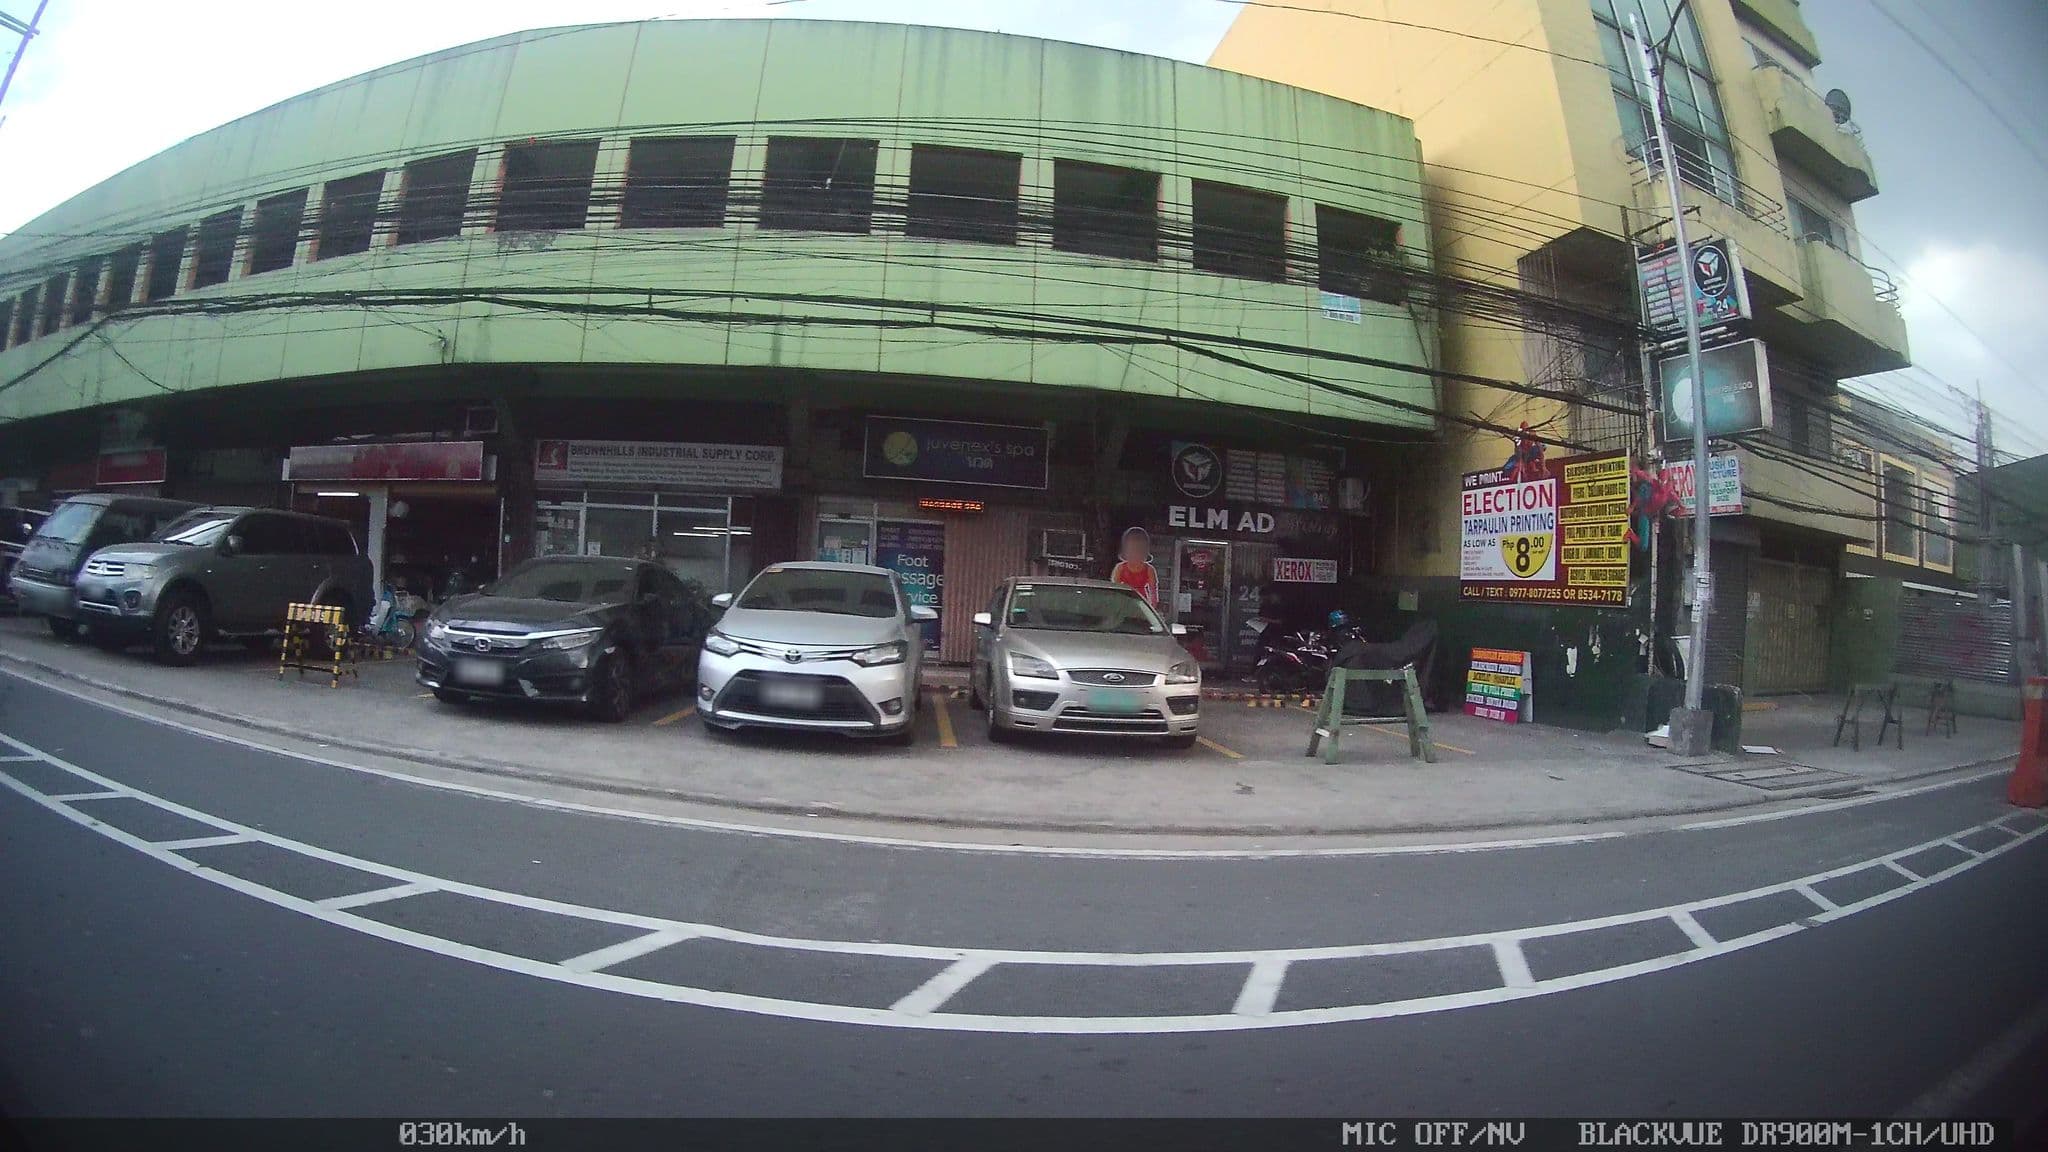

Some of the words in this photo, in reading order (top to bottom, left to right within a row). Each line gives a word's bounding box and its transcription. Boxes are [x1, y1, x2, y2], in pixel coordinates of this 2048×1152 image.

[571, 445, 634, 456] BROWNHILLS
[638, 446, 698, 458] INDUSTRIAL
[703, 448, 742, 459] SUPPLY
[746, 450, 776, 461] CORP.
[1007, 441, 1034, 457] spa
[1464, 475, 1477, 487] WE
[1464, 483, 1553, 515] ELECTION
[1168, 505, 1229, 530] ELM
[1237, 511, 1275, 533] AD
[1464, 516, 1508, 535] TARPAULIN
[1510, 512, 1554, 532] PRINTING
[1464, 540, 1471, 548] AS
[1472, 539, 1486, 548] LOW
[1488, 538, 1496, 547] AS
[897, 553, 929, 568] Foot
[1276, 560, 1313, 581] XEROX
[901, 572, 944, 590] ssage
[1239, 585, 1261, 602] 24
[1463, 586, 1480, 597] CALL
[1486, 587, 1504, 598] TEXT
[1563, 588, 1576, 600] OR
[1578, 588, 1623, 602] 8534-7178
